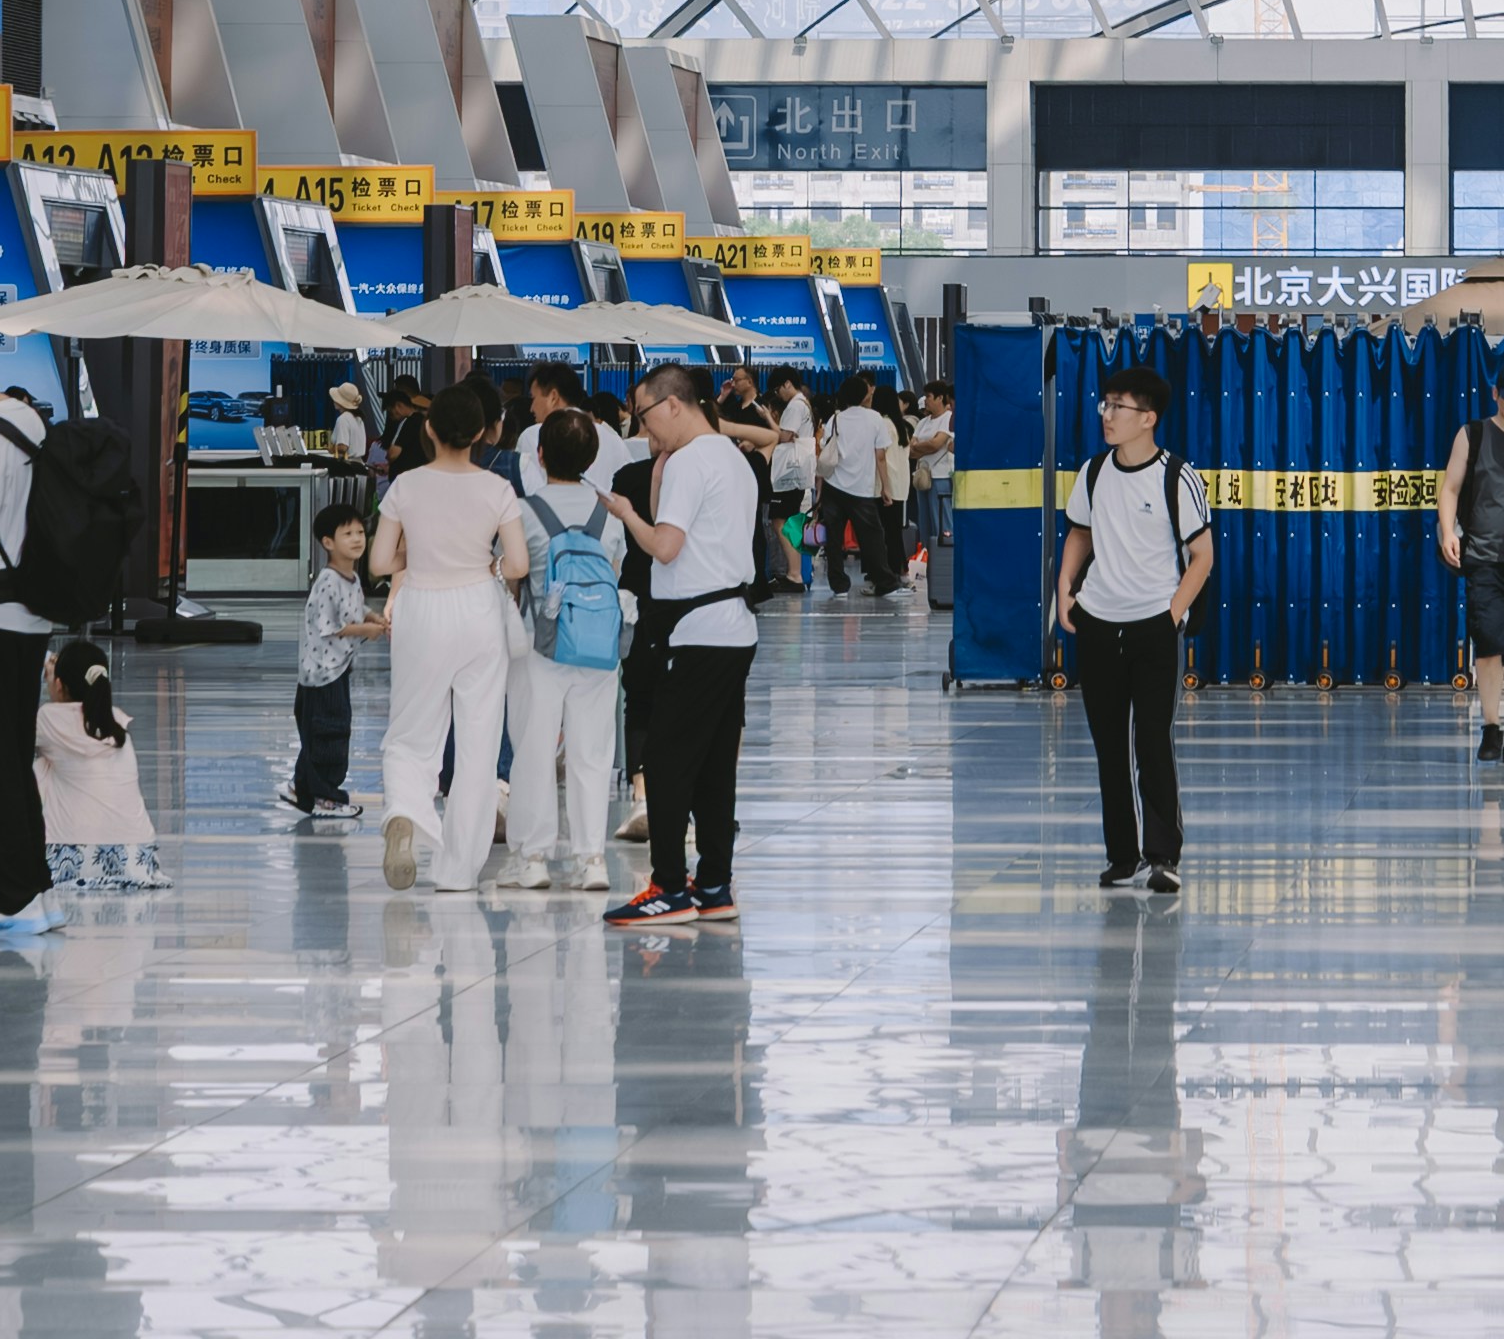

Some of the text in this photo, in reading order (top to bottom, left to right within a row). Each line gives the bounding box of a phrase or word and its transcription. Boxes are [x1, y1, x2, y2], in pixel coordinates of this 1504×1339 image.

[776, 96, 917, 134] 北出口
[161, 143, 243, 168] 检票口
[777, 143, 900, 160] North Exit
[206, 174, 242, 184] Check
[351, 176, 421, 198] 检票口
[352, 202, 420, 212] Ticket Check
[501, 200, 564, 219] 检票口
[502, 224, 563, 232] Ticket Check
[620, 221, 675, 238] 检票口
[753, 243, 802, 258] 检票口
[827, 255, 873, 269] 检票口
[1373, 473, 1437, 508] 安检区域
